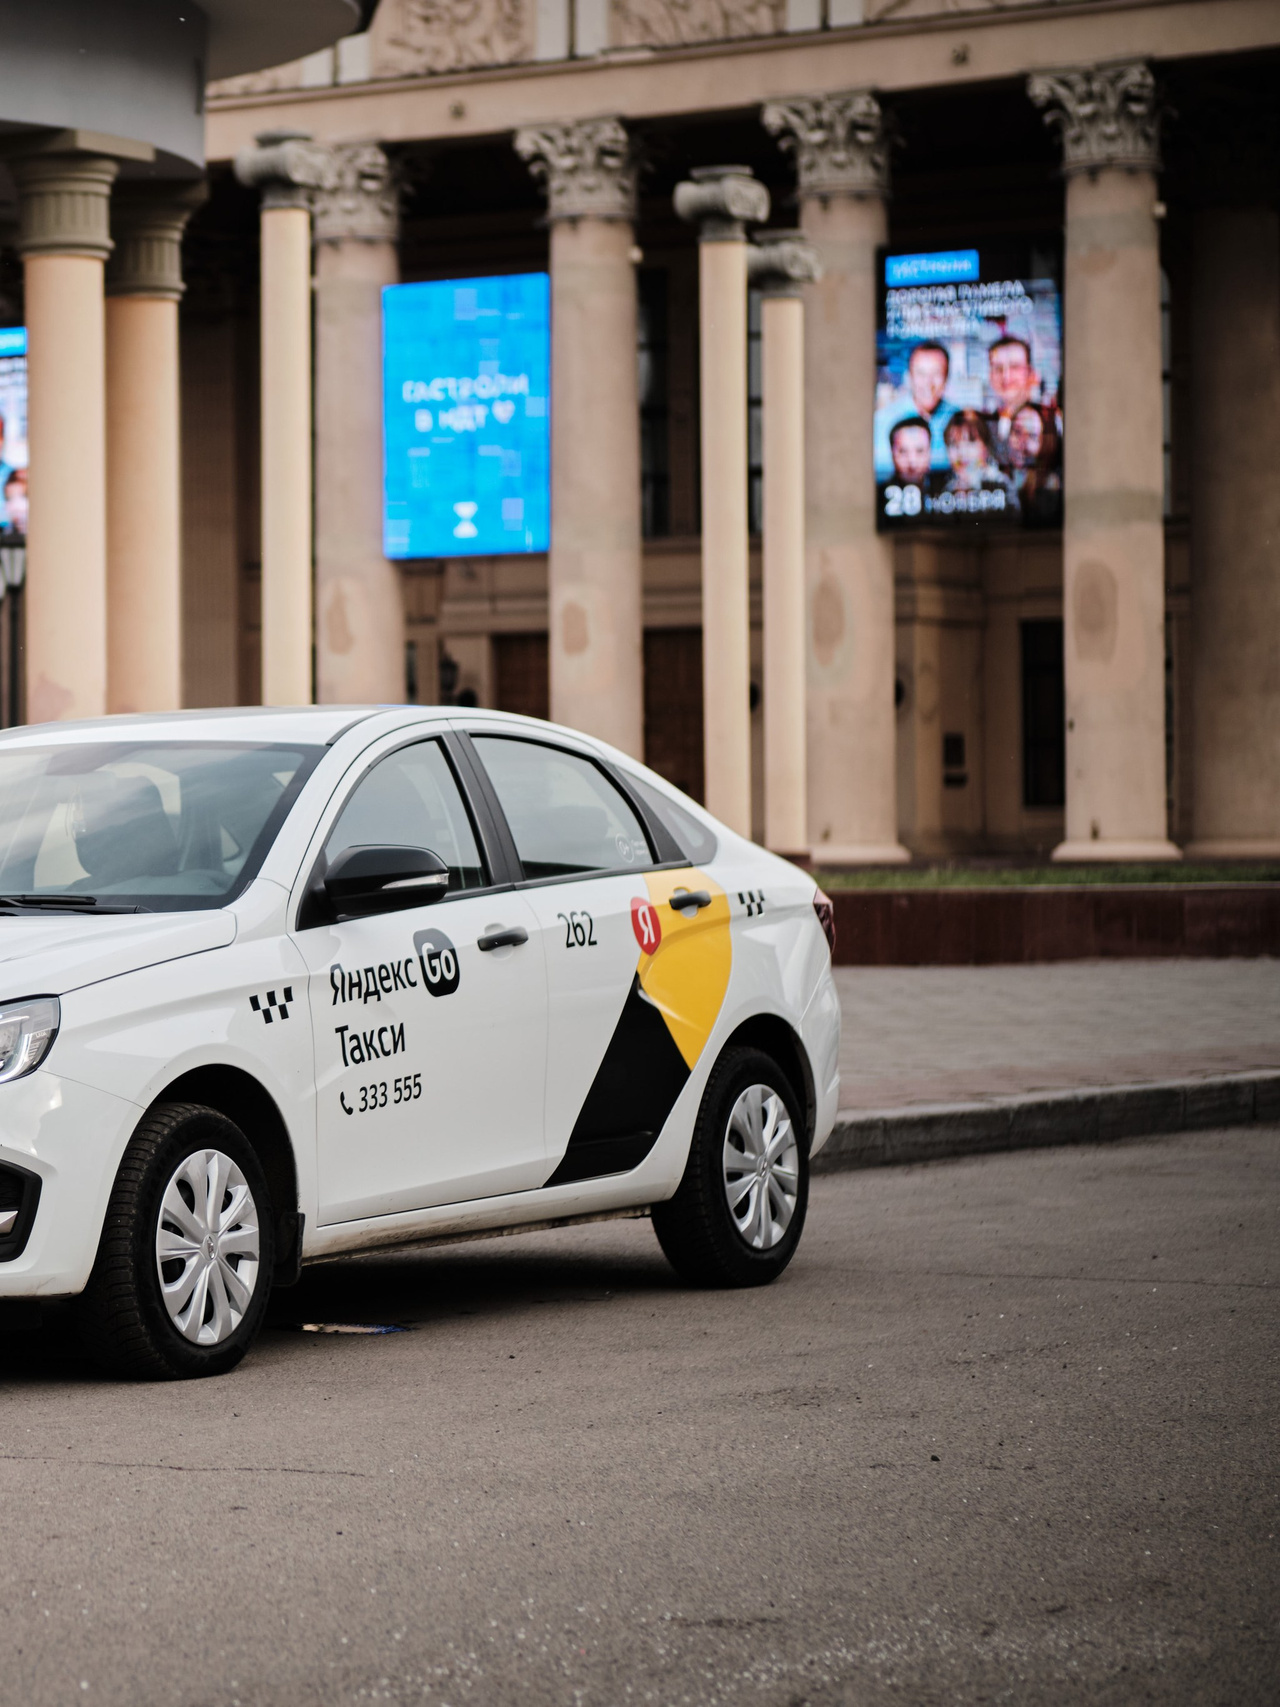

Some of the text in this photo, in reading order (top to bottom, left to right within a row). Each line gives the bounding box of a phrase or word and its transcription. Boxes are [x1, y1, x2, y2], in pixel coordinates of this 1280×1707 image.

[557, 910, 598, 949] 262
[637, 905, 656, 946] Я
[330, 942, 457, 1006] Яндекс Go
[334, 1022, 407, 1068] Такси
[358, 1073, 423, 1113] 333 555
